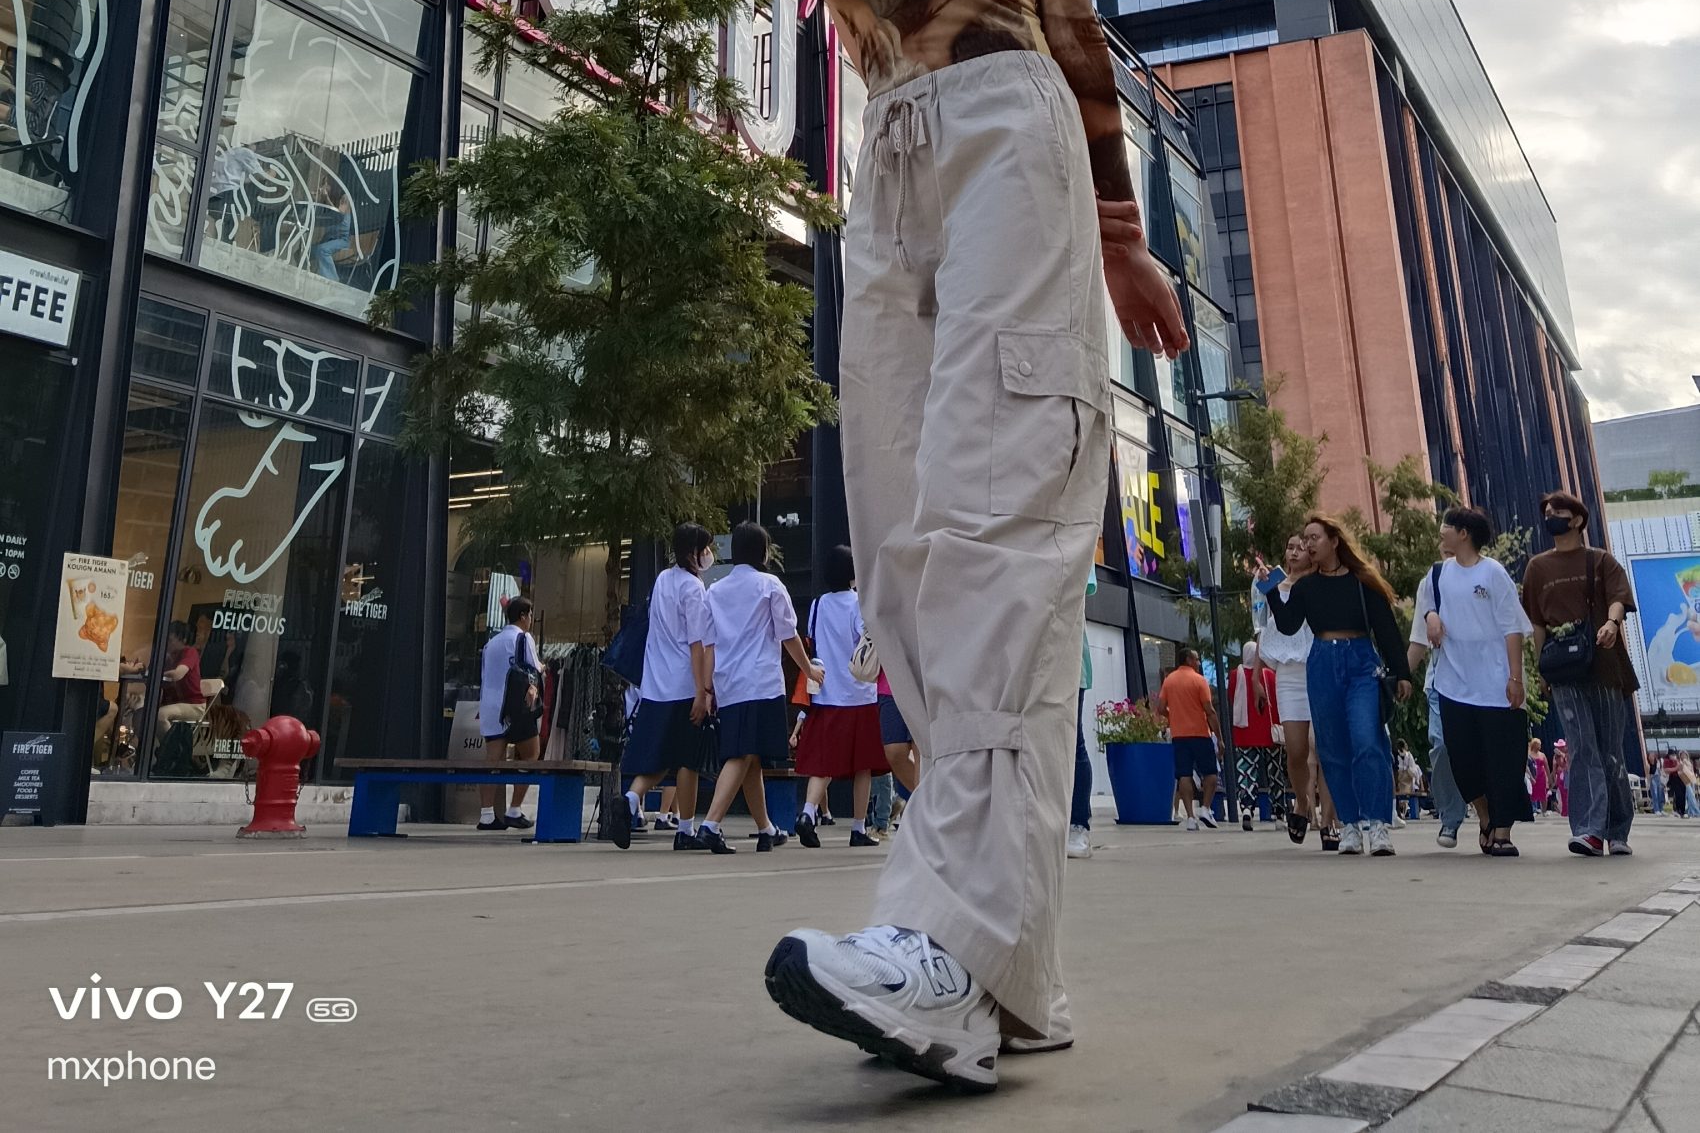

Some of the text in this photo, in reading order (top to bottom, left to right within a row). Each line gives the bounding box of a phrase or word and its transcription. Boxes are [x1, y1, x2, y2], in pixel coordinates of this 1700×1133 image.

[0, 274, 67, 324] FFEE
[5, 535, 28, 546] DAILY
[5, 548, 25, 559] 10PM
[93, 567, 117, 575] AMANN
[222, 589, 284, 613] FIERCELY
[345, 599, 388, 620] FIRE TIGER
[212, 610, 287, 635] DELICIOUS
[12, 743, 53, 755] FIRE TIGER
[213, 738, 232, 753] FIRE
[463, 737, 483, 749] SHU
